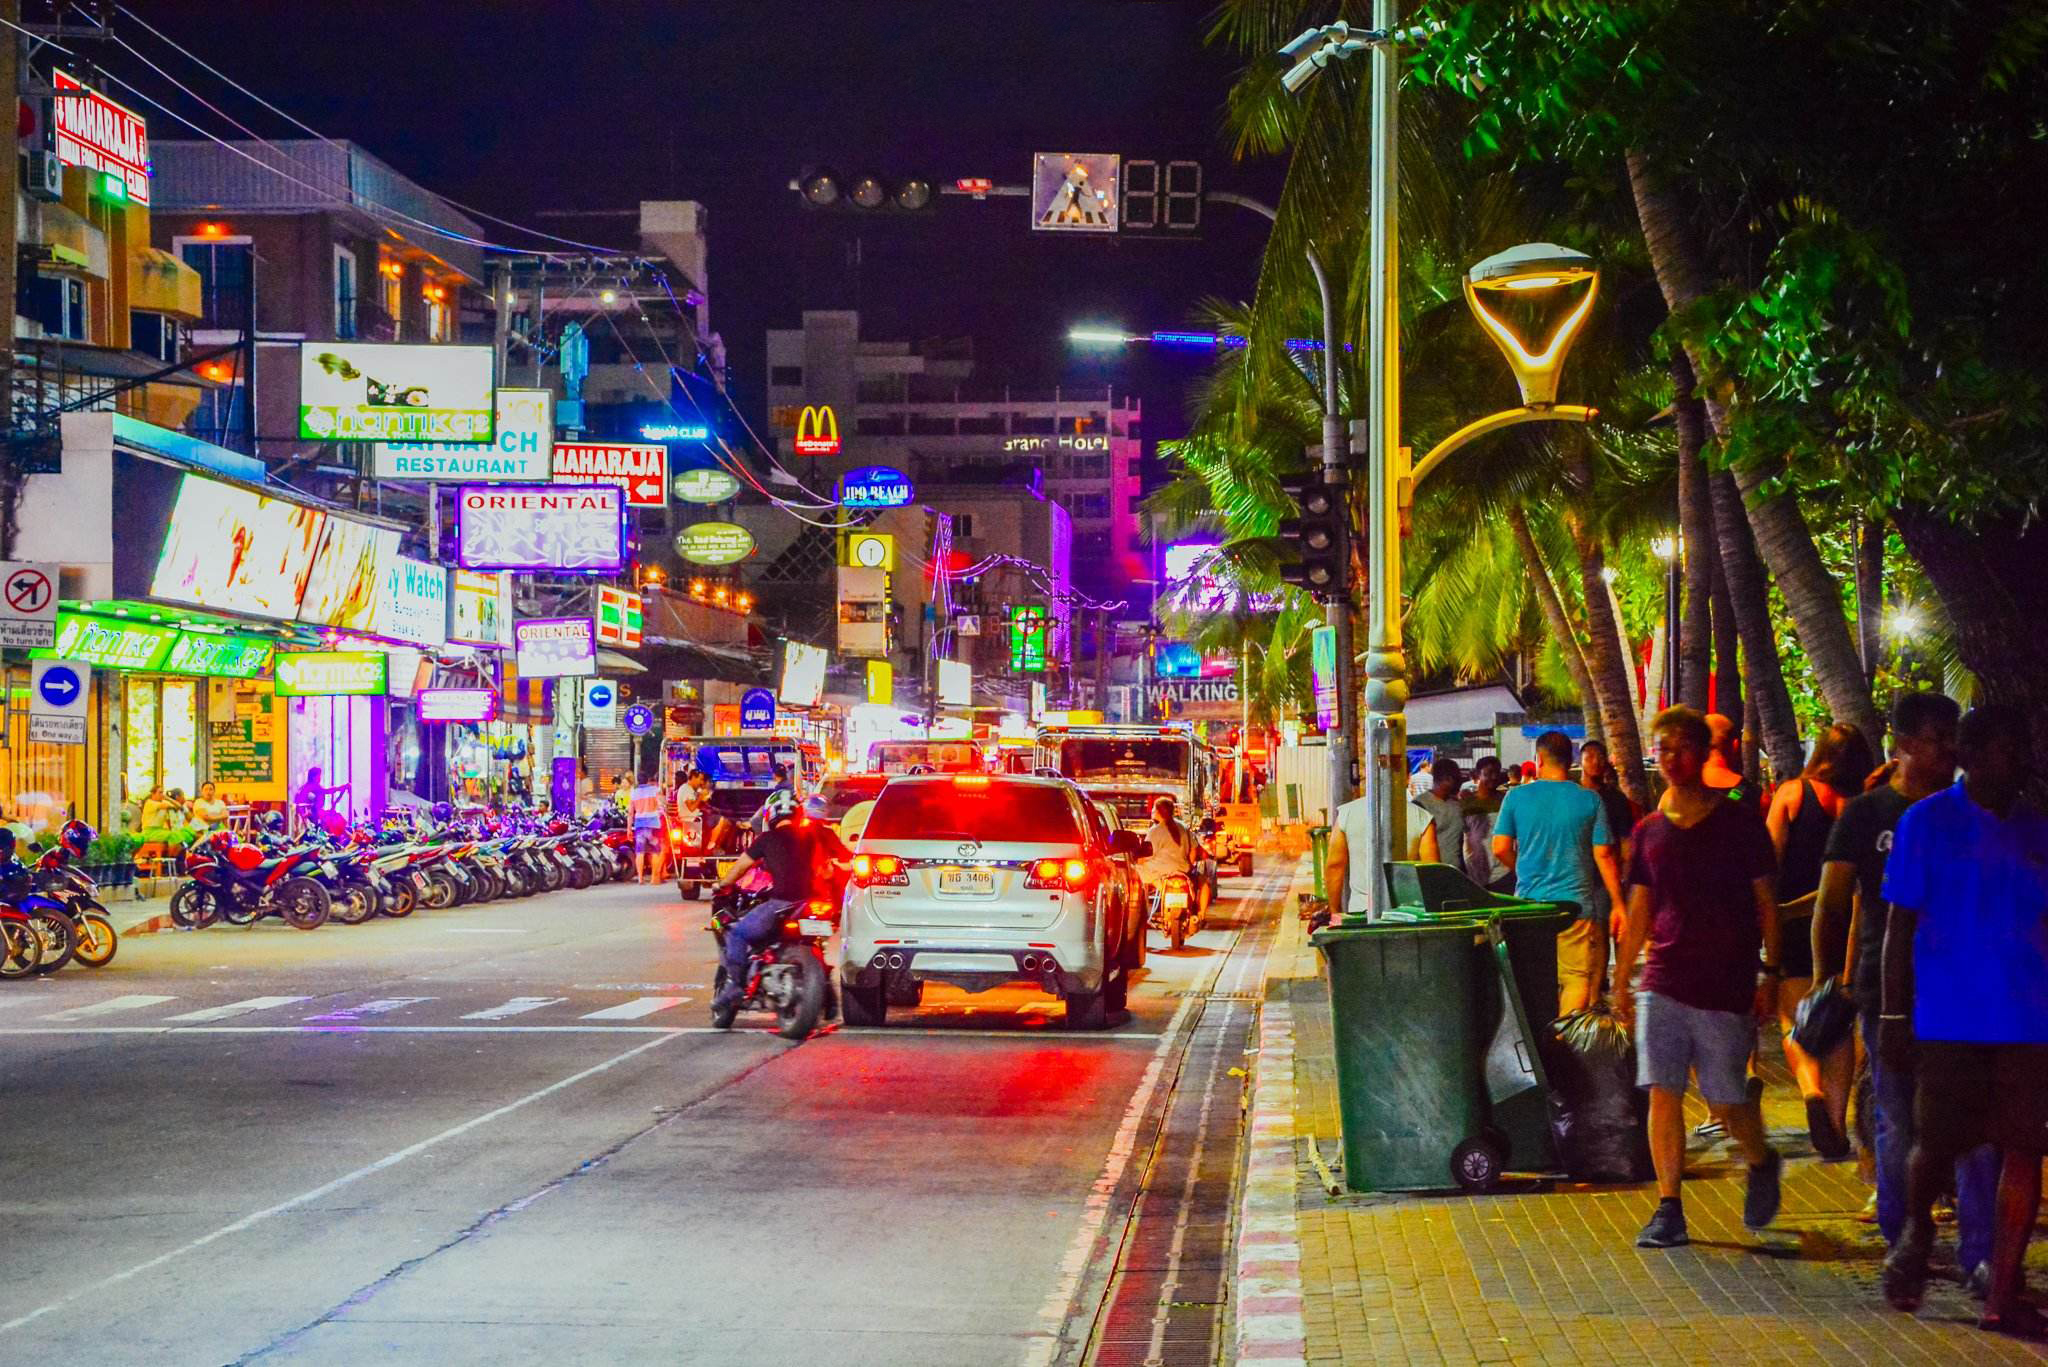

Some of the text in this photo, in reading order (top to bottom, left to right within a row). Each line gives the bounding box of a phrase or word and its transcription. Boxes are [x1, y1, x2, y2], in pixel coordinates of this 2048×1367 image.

[396, 457, 528, 474] RESTAURANT
[553, 448, 661, 476] MAHARAJA
[467, 496, 615, 509] ORIENTAL
[405, 563, 443, 602] Watch
[519, 624, 589, 640] ORIENTAL
[36, 637, 49, 646] left
[1146, 684, 1238, 703] WALKING
